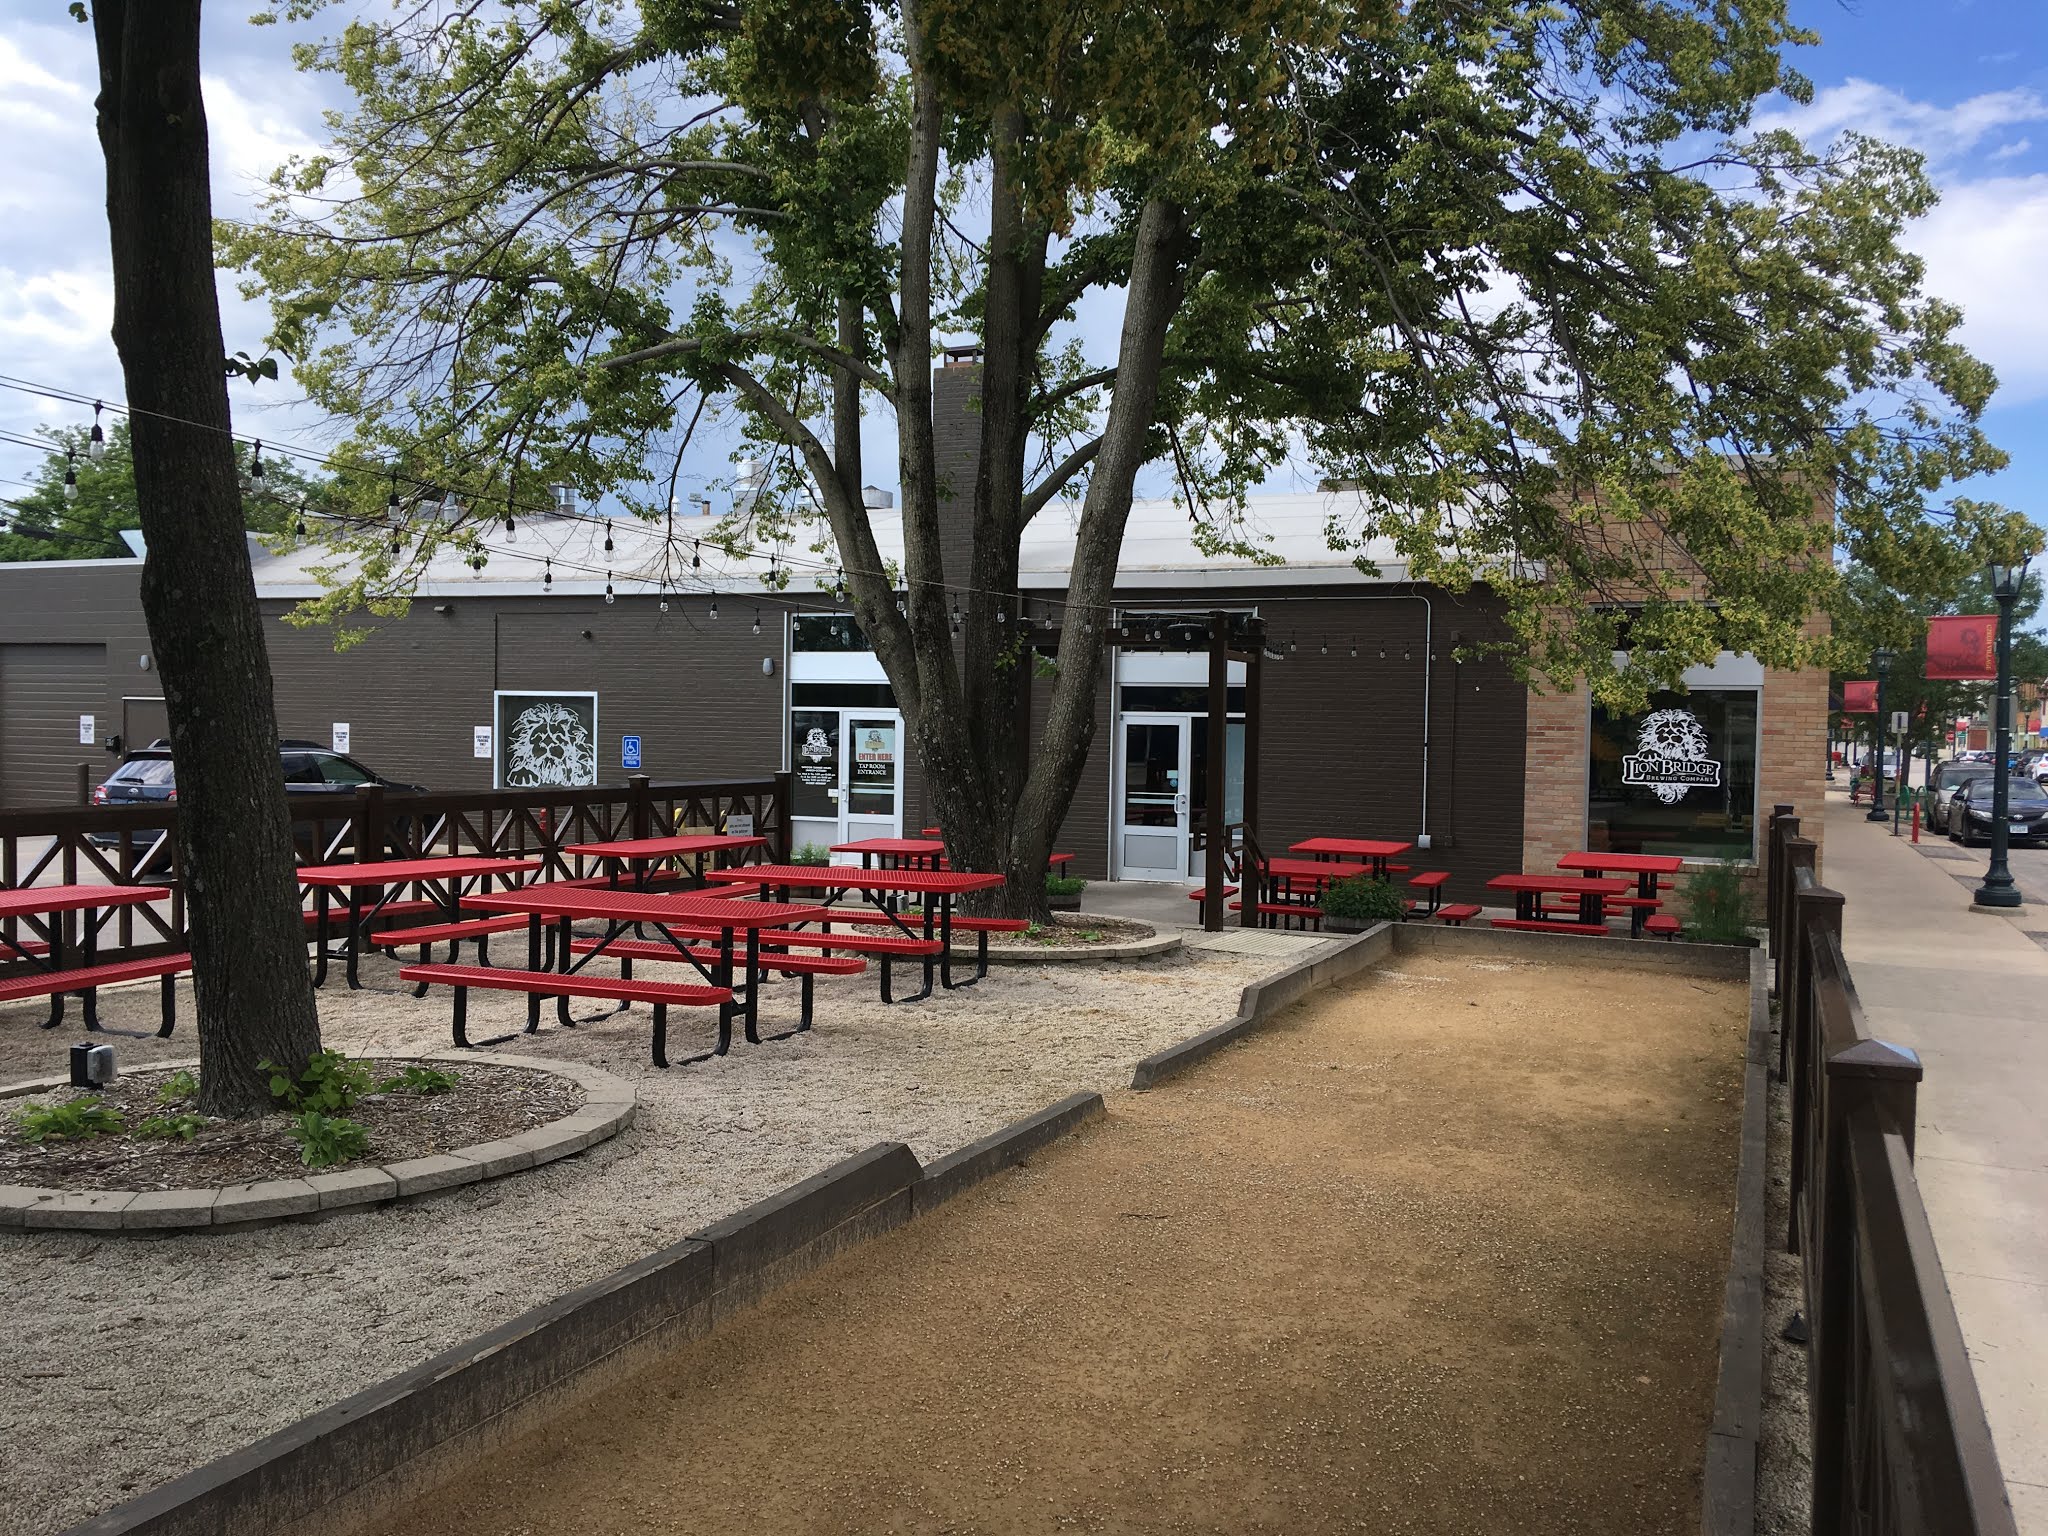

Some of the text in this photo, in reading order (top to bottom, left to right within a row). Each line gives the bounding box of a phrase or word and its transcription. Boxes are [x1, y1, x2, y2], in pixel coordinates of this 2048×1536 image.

[858, 752, 893, 761] ENTER HERE
[1627, 760, 1715, 780] LION BRIDGE
